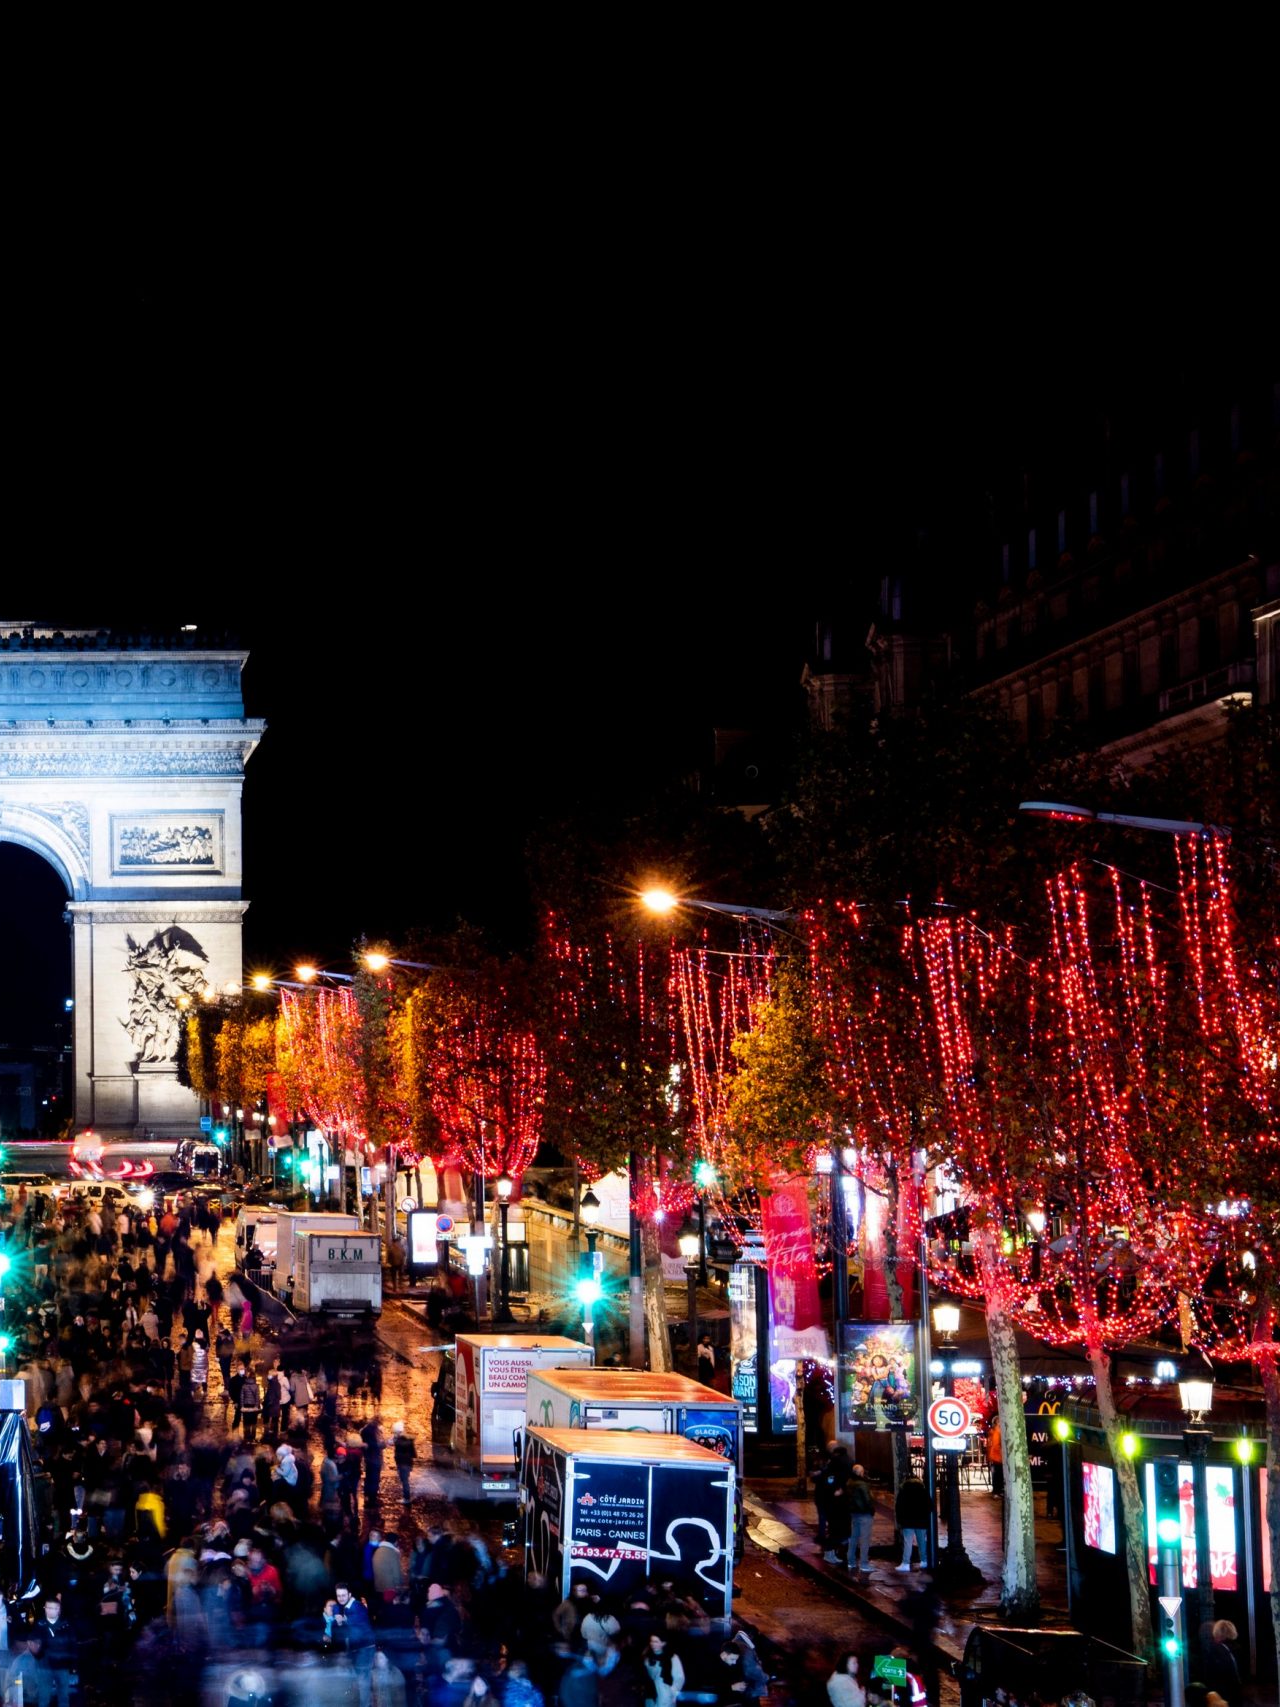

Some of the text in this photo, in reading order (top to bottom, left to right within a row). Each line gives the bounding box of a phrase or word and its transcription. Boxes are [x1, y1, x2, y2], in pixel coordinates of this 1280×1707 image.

[938, 1410, 962, 1427] 50
[599, 1494, 645, 1505] CÔTÉ JARDIN
[575, 1528, 601, 1537] PARIS
[608, 1530, 646, 1540] CANNES
[571, 1548, 647, 1560] 04.93.47.75.55
